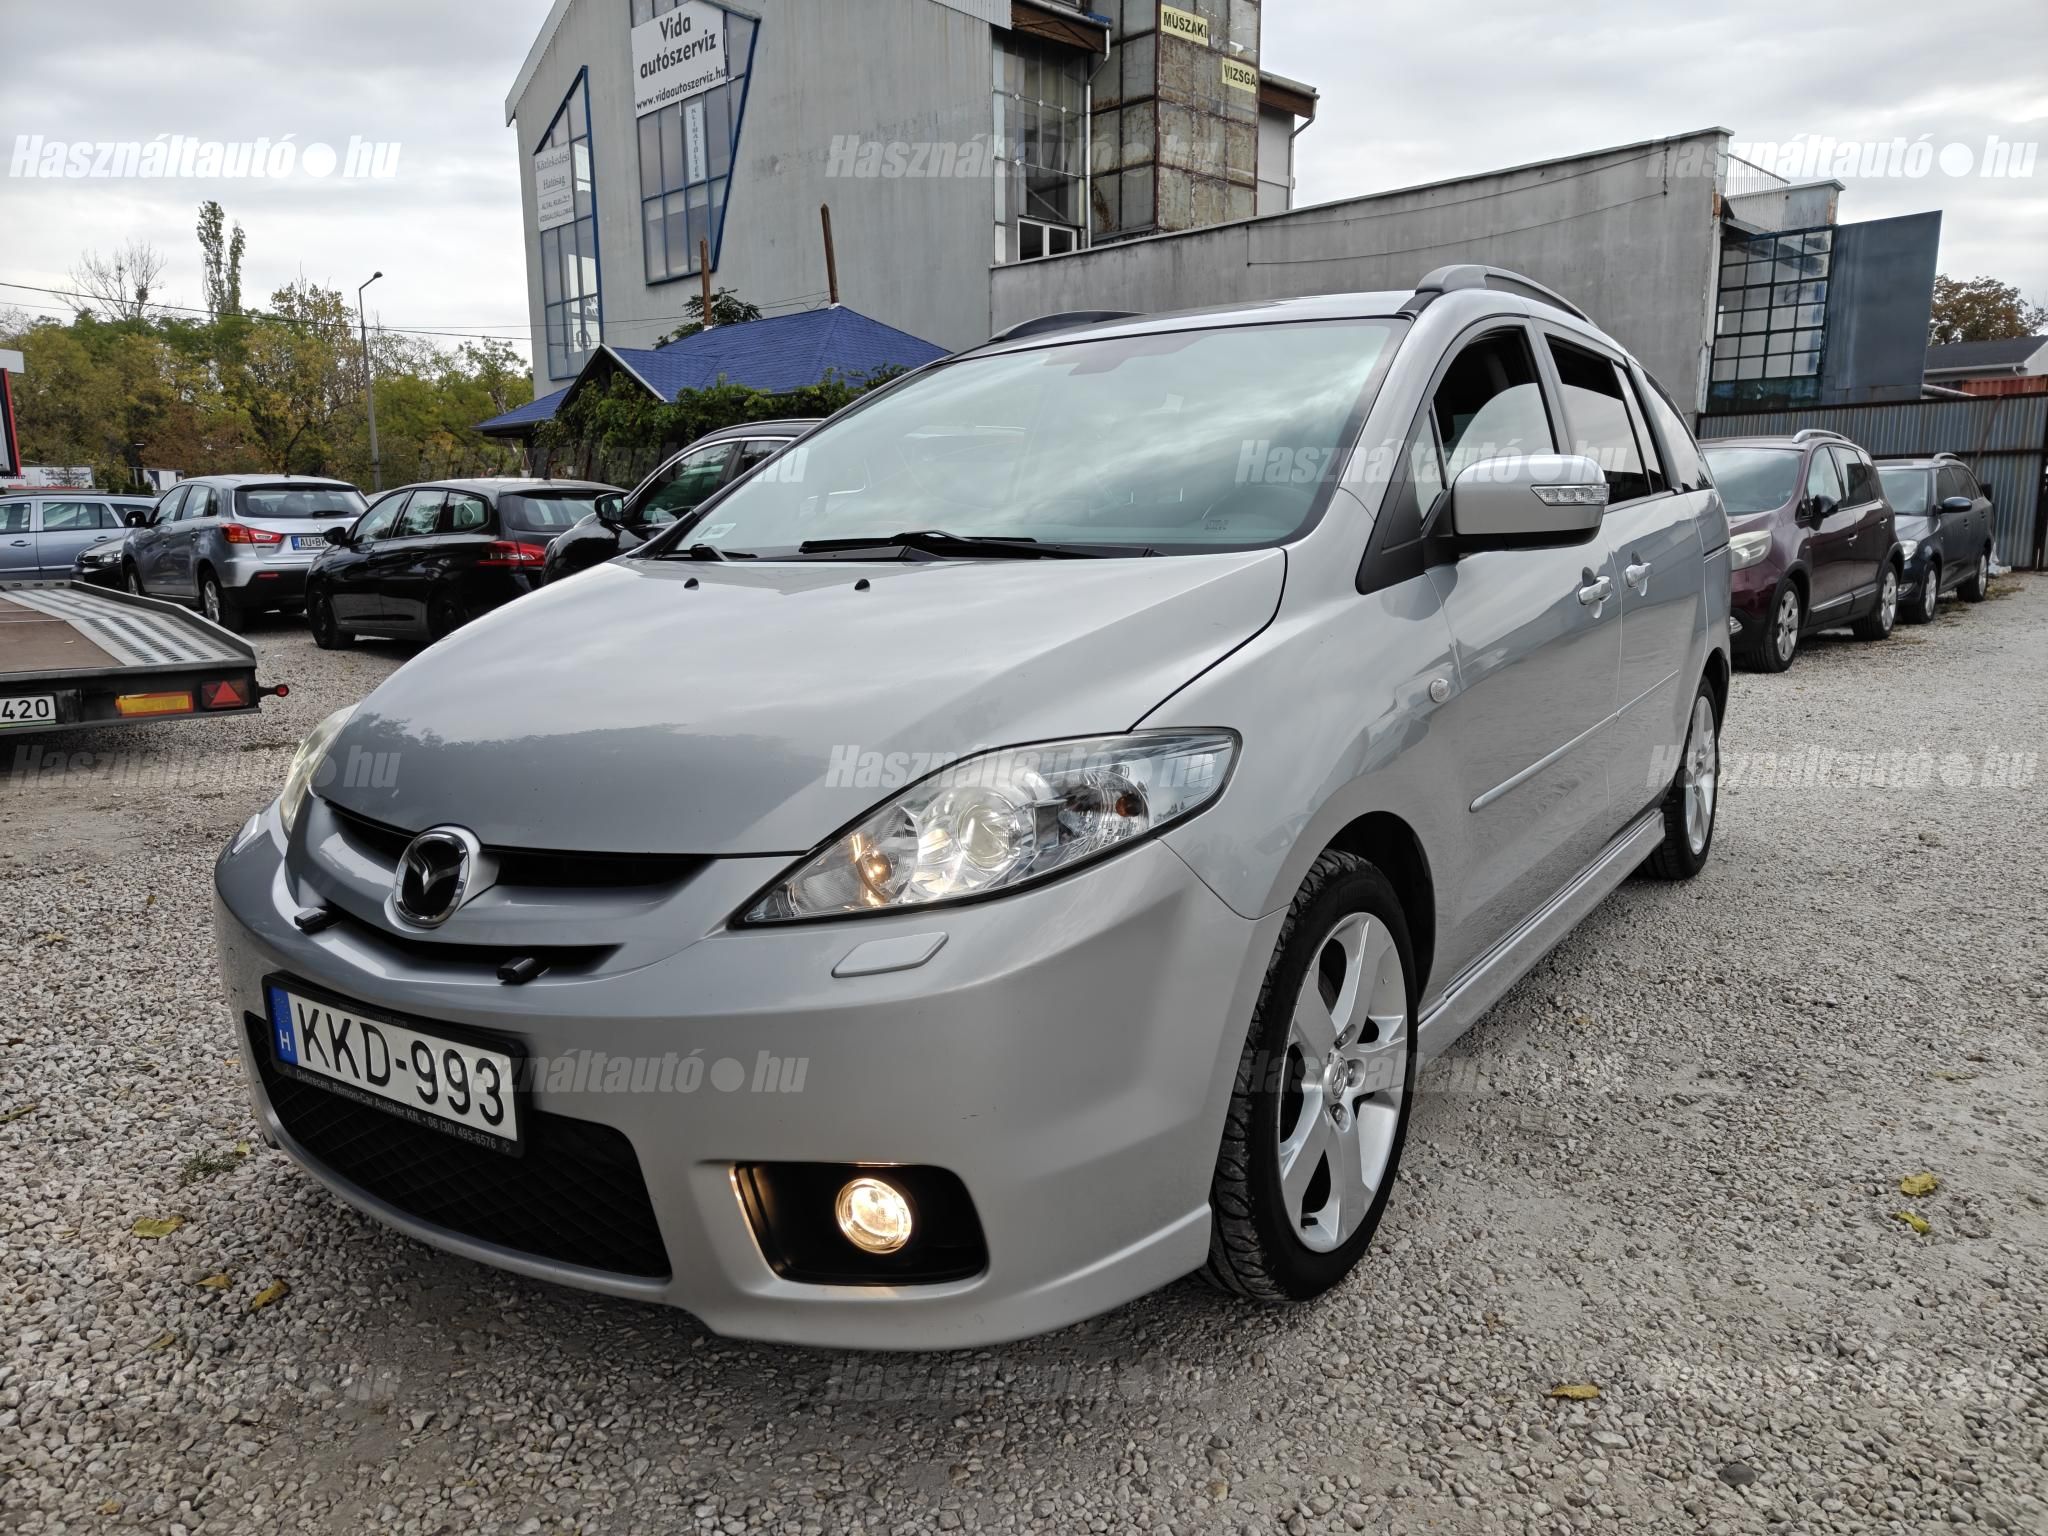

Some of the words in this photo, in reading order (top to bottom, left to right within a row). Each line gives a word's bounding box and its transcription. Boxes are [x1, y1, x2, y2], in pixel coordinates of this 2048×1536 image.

[659, 11, 691, 42] Vida
[640, 29, 716, 78] autószerviz
[636, 66, 726, 110] www.vidaautoszerviz.hu
[1224, 64, 1256, 87] VIZSGA
[1, 698, 50, 720] 420
[279, 1029, 291, 1052] H
[297, 1002, 504, 1127] KKD-993
[427, 1115, 439, 1129] 06
[439, 1119, 456, 1136] (30)
[457, 1127, 498, 1150] 495-6576
